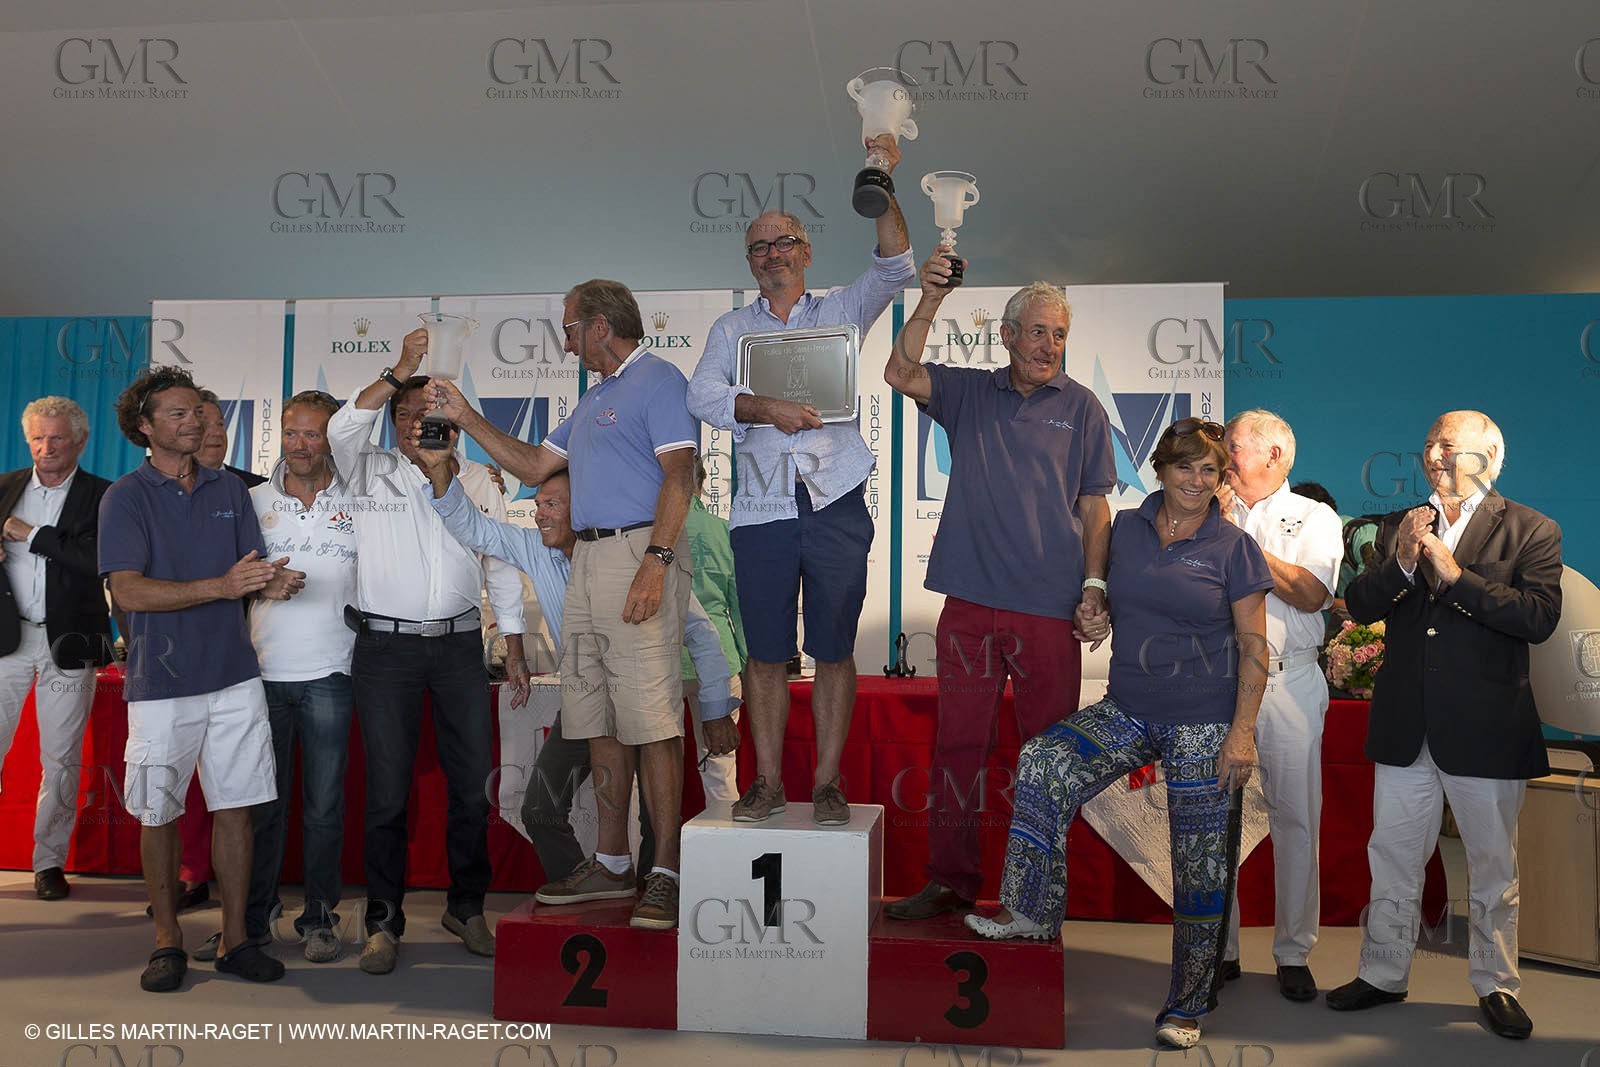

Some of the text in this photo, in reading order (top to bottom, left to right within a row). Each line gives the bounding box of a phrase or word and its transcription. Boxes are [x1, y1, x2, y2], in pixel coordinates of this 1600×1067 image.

[331, 340, 392, 354] ROLEX
[641, 335, 692, 348] OLEX
[946, 333, 1003, 346] ROLE
[751, 851, 784, 927] 1
[560, 933, 608, 1009] 2
[943, 951, 990, 1029] 3
